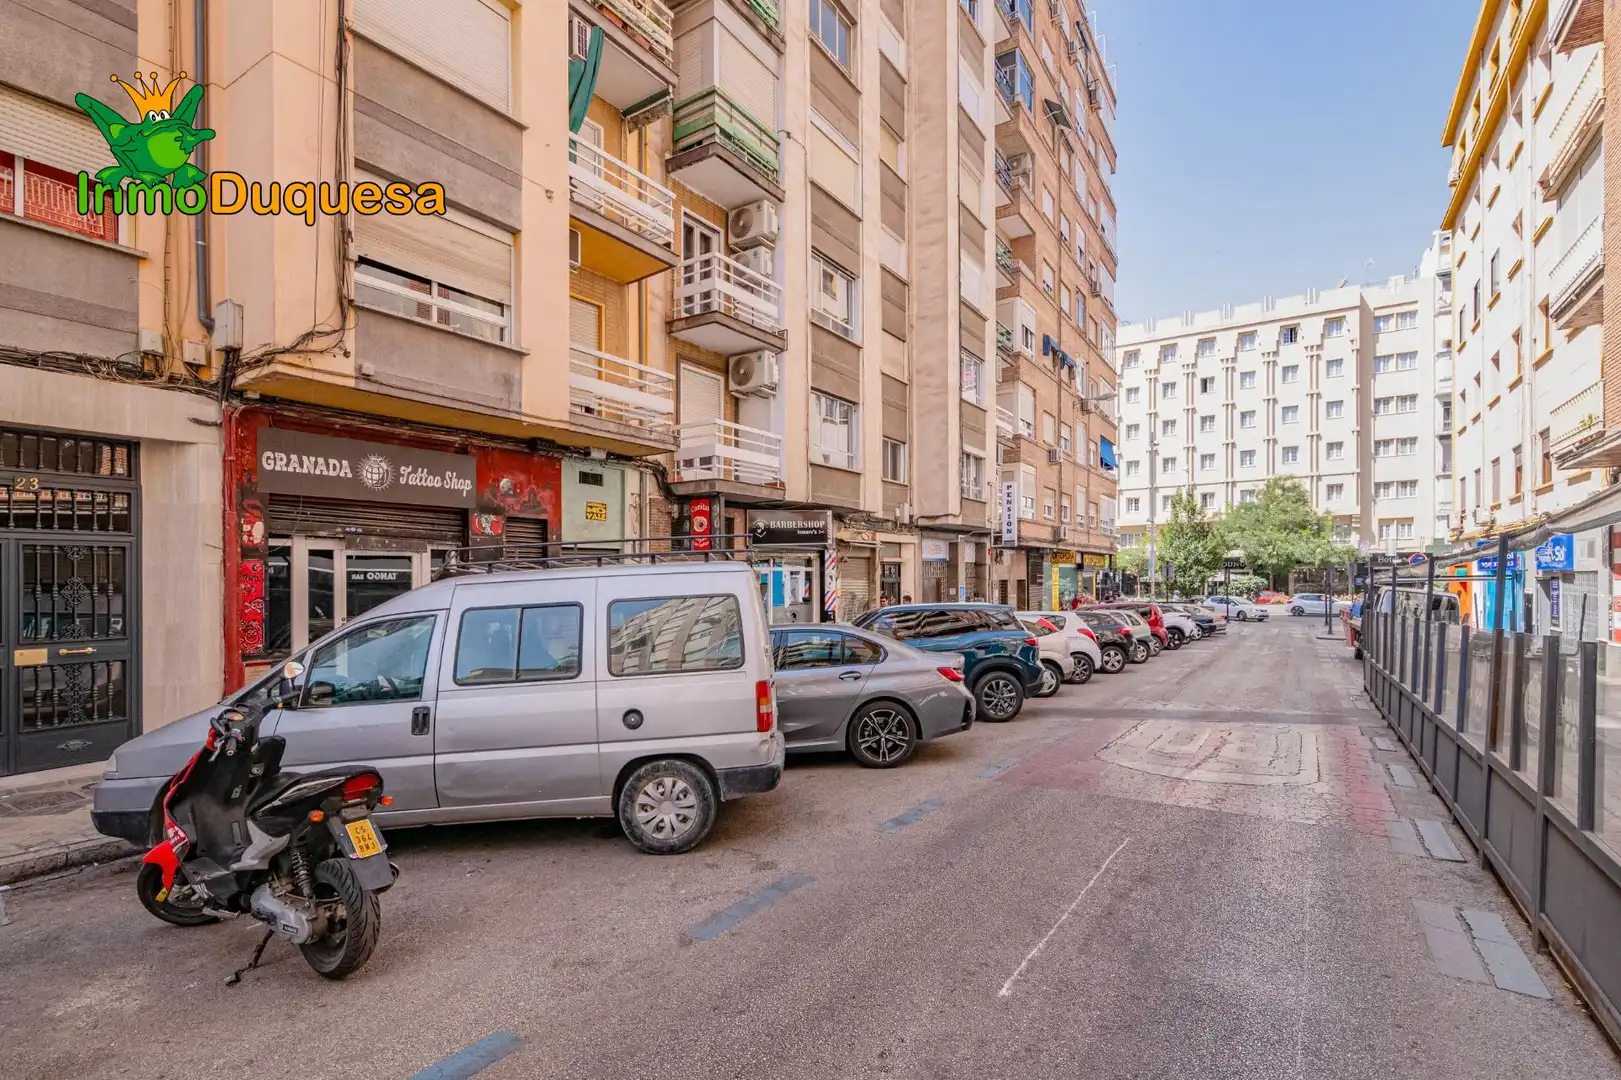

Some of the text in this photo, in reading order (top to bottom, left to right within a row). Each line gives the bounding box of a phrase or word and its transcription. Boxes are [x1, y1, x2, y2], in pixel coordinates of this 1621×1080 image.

[261, 451, 473, 497] GRANADA Tattoo Shop
[15, 477, 39, 491] 23
[770, 520, 825, 529] BARBERSHOP
